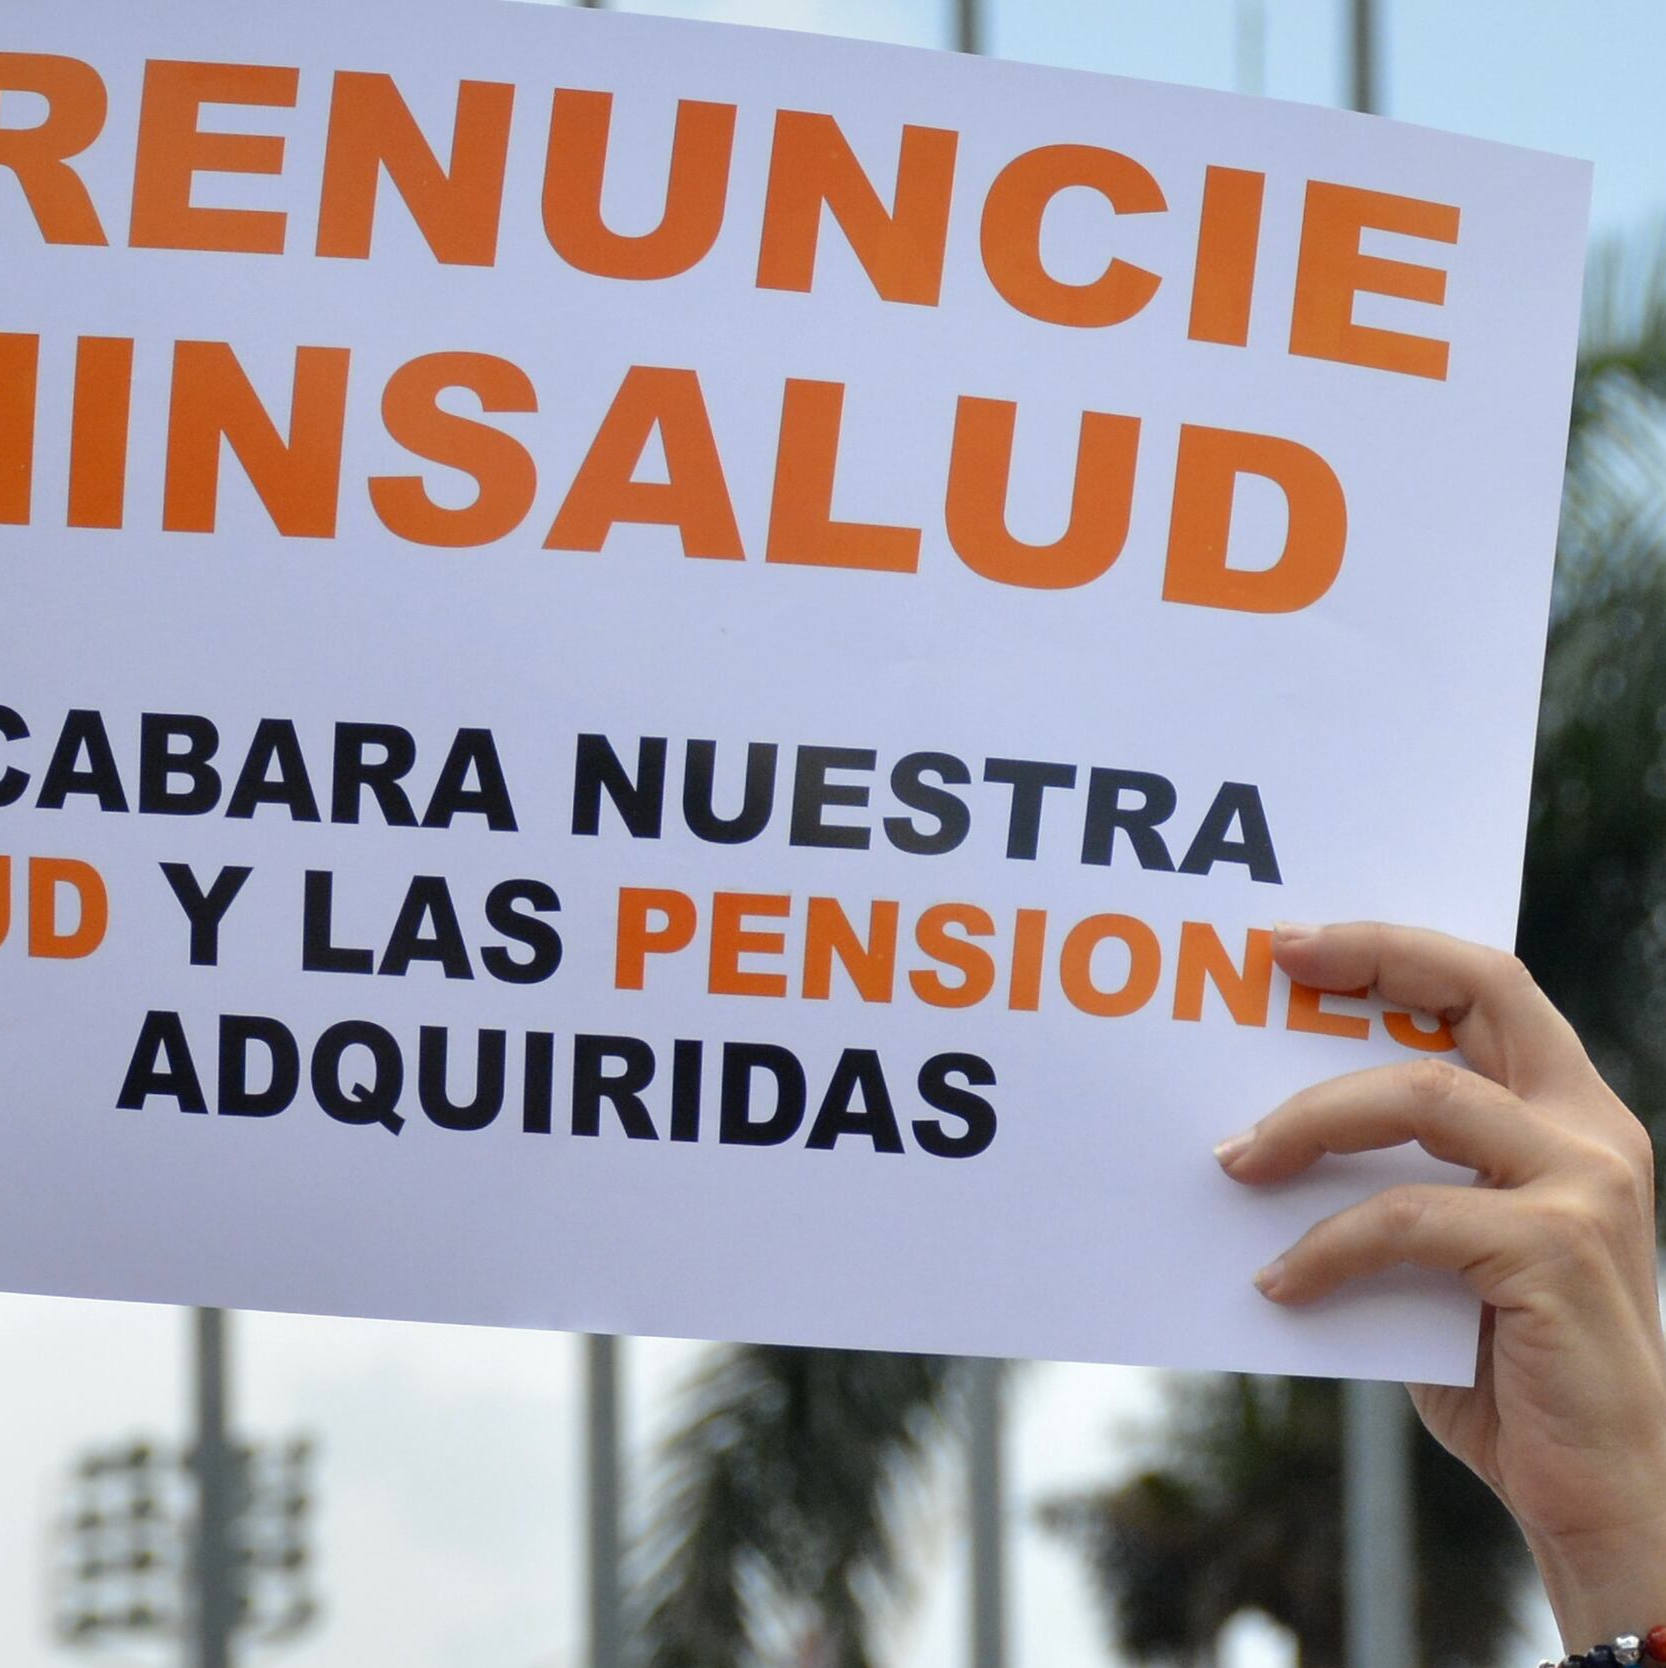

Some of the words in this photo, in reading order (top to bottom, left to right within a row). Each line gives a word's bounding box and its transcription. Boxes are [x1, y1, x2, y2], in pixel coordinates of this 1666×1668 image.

[571, 734, 1283, 884] NUESTRA
[158, 862, 254, 967] Y
[302, 870, 563, 985] LAS
[116, 1011, 997, 1158] ADQUIRIDAS
